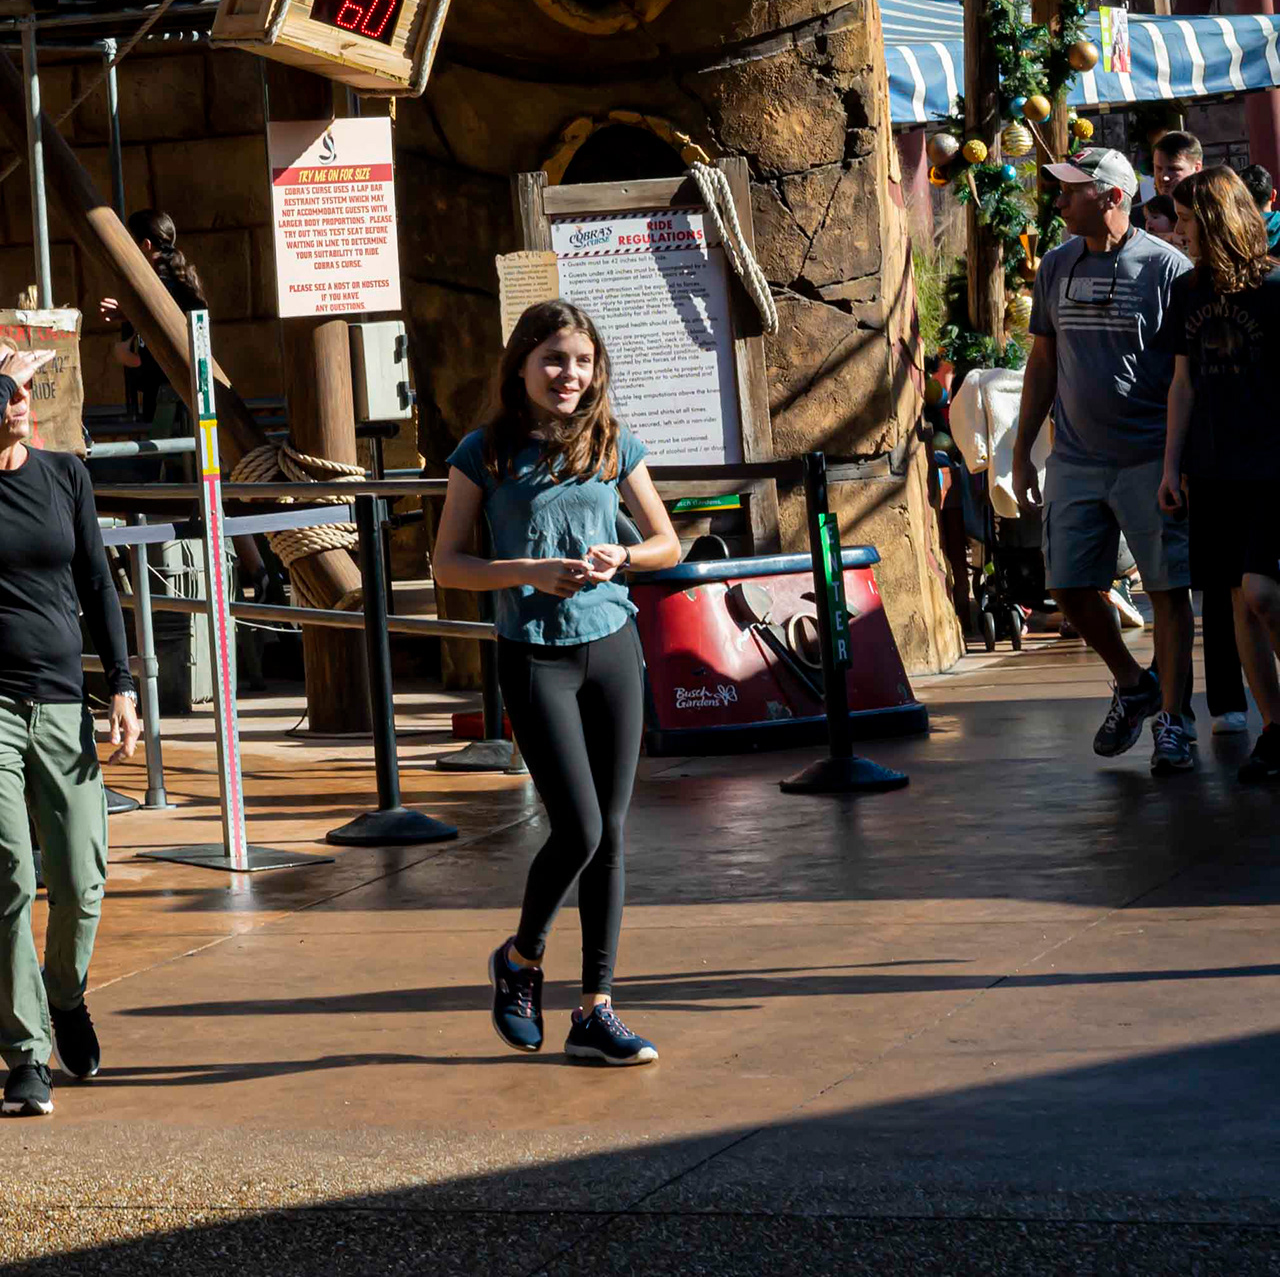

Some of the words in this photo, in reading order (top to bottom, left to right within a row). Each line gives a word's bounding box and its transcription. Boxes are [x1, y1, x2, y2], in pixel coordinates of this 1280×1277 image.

[299, 171, 312, 183] TRY
[314, 170, 327, 182] ME
[328, 170, 338, 181] ON
[340, 169, 353, 180] FOR
[355, 168, 371, 180] SIZE
[285, 187, 310, 195] COBRA'S
[312, 186, 331, 194] CURSE
[333, 185, 349, 193] USES
[357, 184, 368, 192] LAP
[284, 197, 319, 206] RESTRAINT
[322, 196, 347, 205] SYSTEM
[349, 195, 369, 203] WHICH
[282, 209, 294, 217] NOT
[297, 207, 343, 216] ACCOMMODATE
[345, 206, 369, 214] GUESTS
[279, 220, 302, 228] LARGER
[305, 219, 320, 227] BODY
[370, 215, 392, 223] PLEASE
[647, 220, 673, 231] RIDE
[313, 229, 327, 237] THIS
[329, 228, 345, 236] TEST
[347, 227, 363, 235] SEAT
[365, 226, 388, 234] BEFORE
[286, 241, 314, 249] WAITING
[325, 239, 339, 247] LINE
[341, 238, 350, 246] TO
[351, 237, 387, 245] DETERMINE
[618, 229, 704, 246] REGULATIONS
[296, 251, 312, 259] YOUR
[314, 249, 353, 258] SUITABILITY
[355, 248, 363, 256] TO
[314, 261, 340, 270] COBRA'S
[289, 284, 313, 292] PLEASE
[314, 283, 326, 291] SEE
[328, 282, 332, 290] A
[334, 282, 350, 290] HOST
[352, 281, 360, 289] OR
[362, 280, 389, 288] HOSTESS
[321, 293, 327, 301] IF
[343, 292, 359, 300] HAVE
[316, 304, 328, 312] ANY
[827, 523, 848, 660] ENTER
[674, 686, 713, 700] Busch
[676, 696, 721, 709] Gardens
